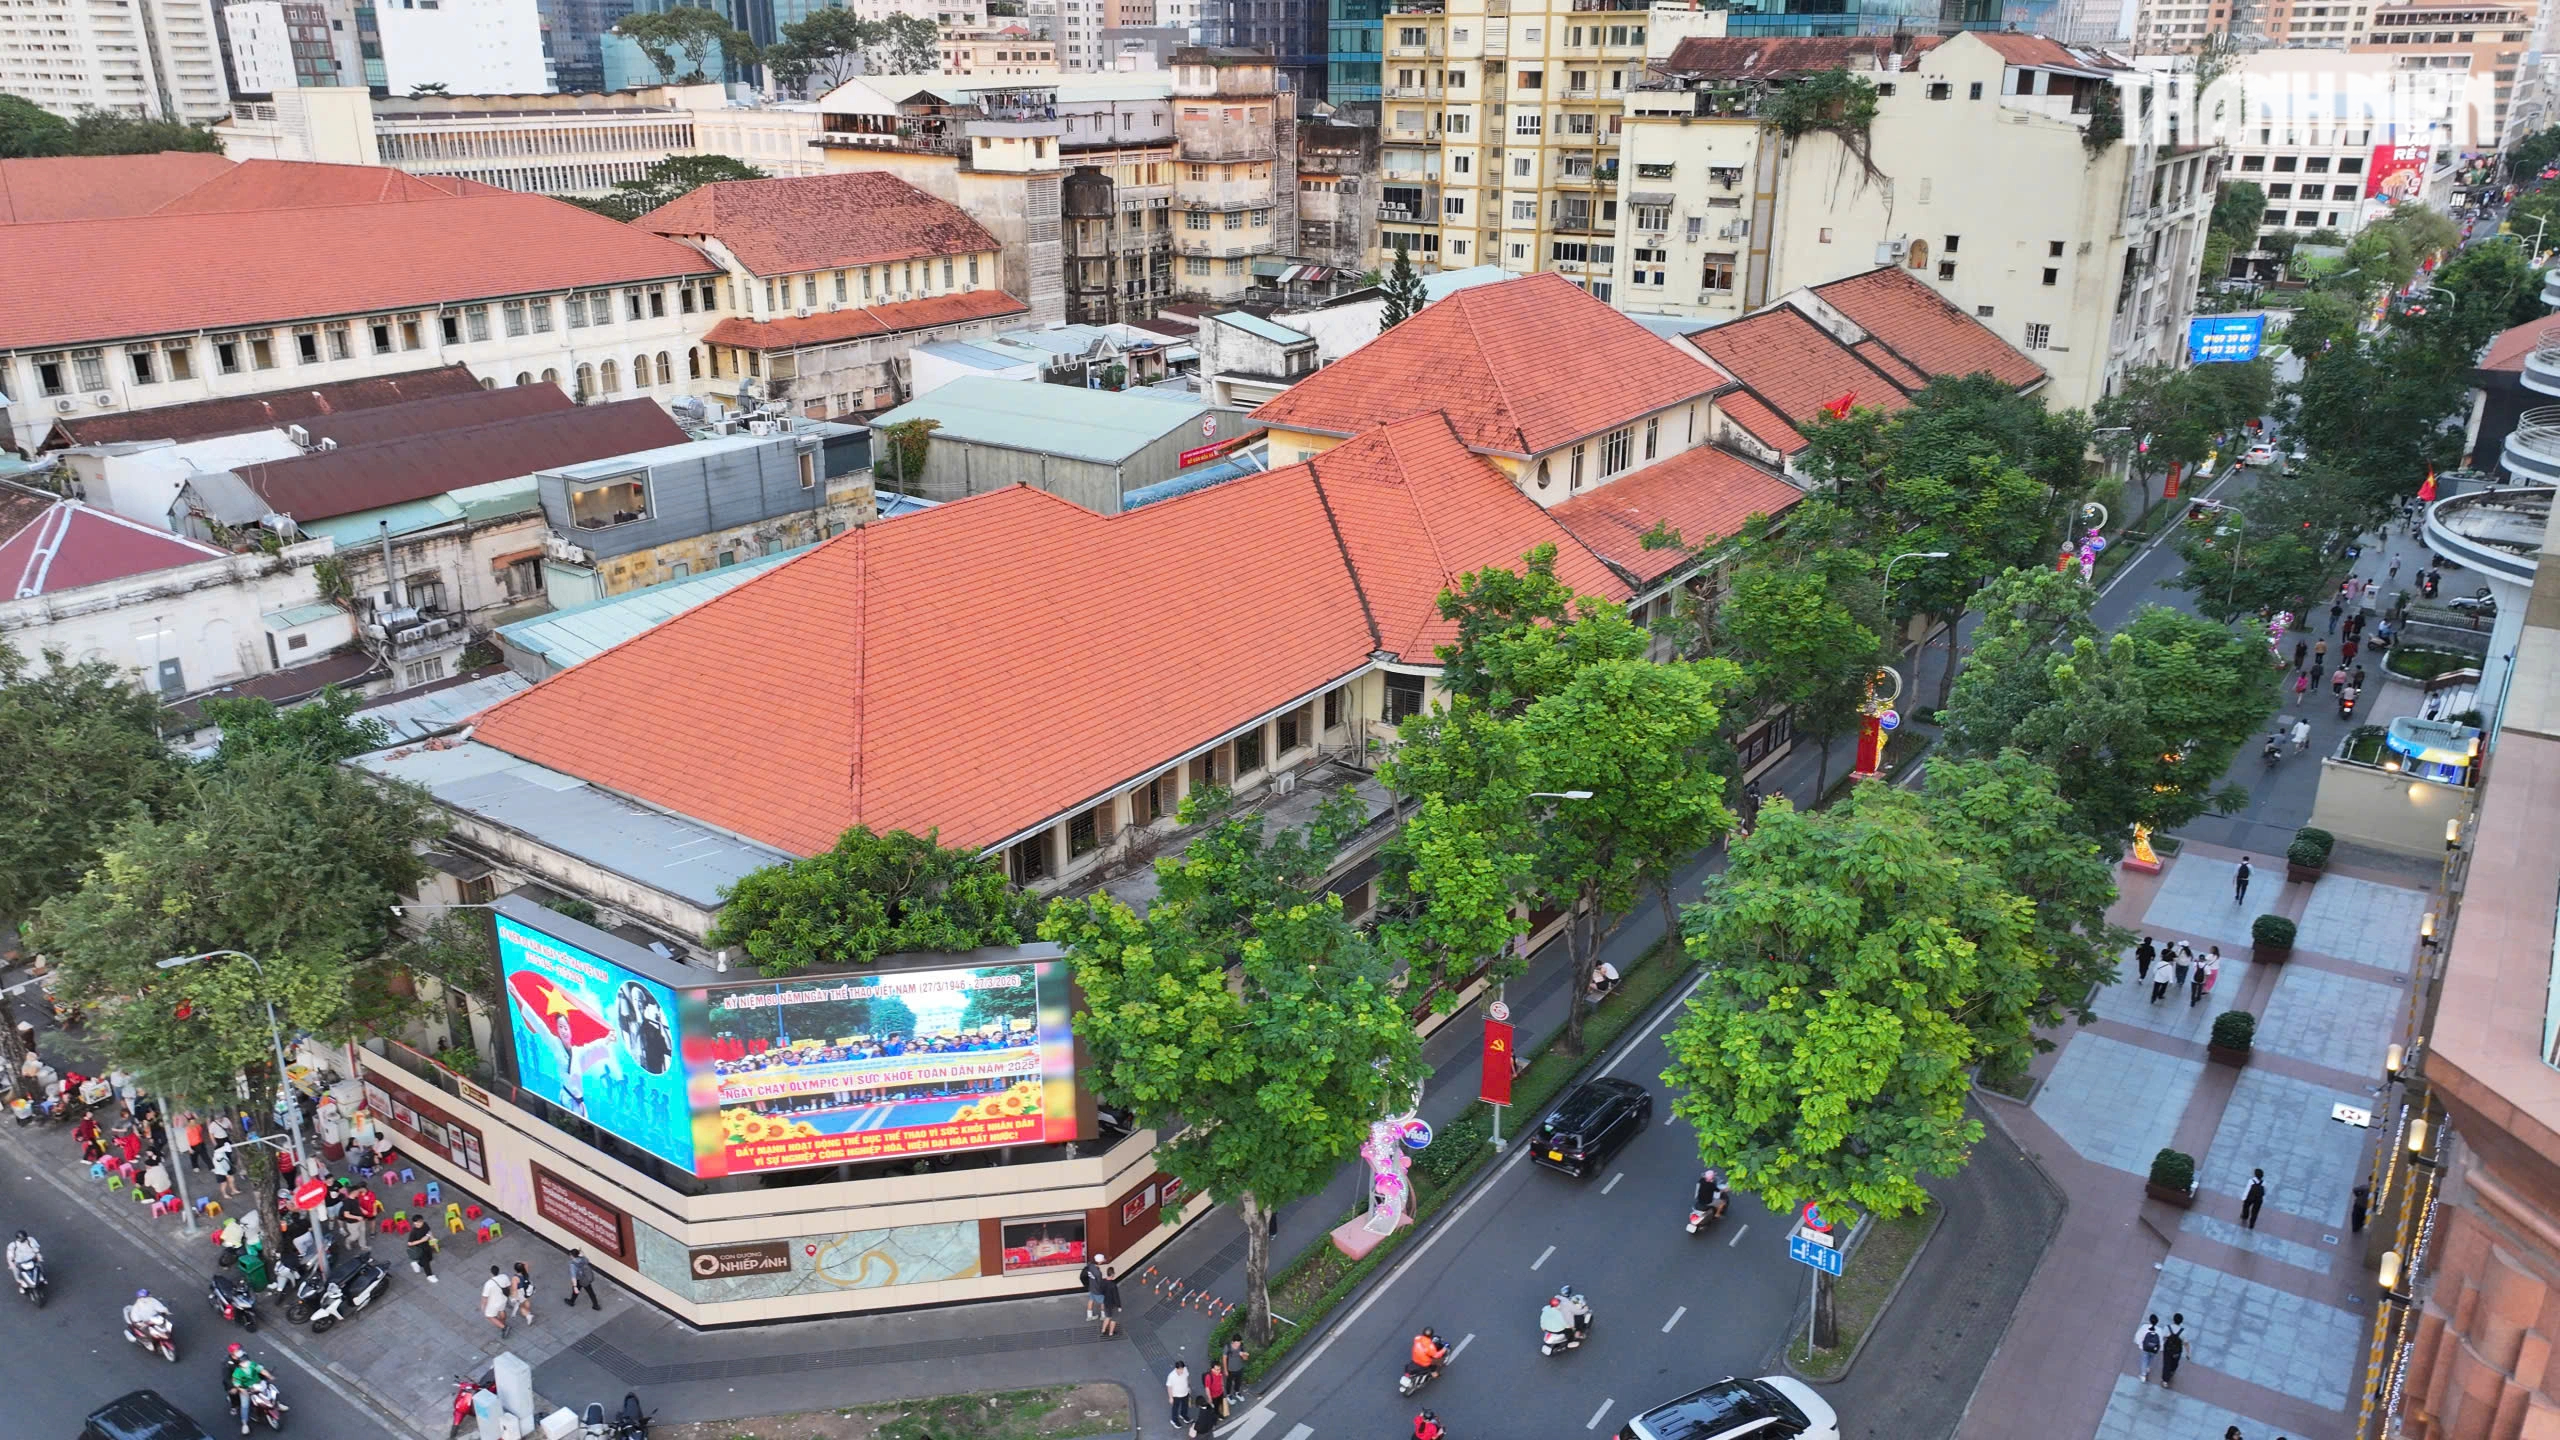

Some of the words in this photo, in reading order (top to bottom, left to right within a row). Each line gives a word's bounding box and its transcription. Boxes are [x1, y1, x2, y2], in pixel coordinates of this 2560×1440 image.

[740, 994, 764, 1009] NIỆM
[849, 987, 872, 998] THAO
[895, 984, 917, 994] NAM
[790, 1078, 839, 1092] OLYMPIC
[904, 1129, 927, 1139] THAO
